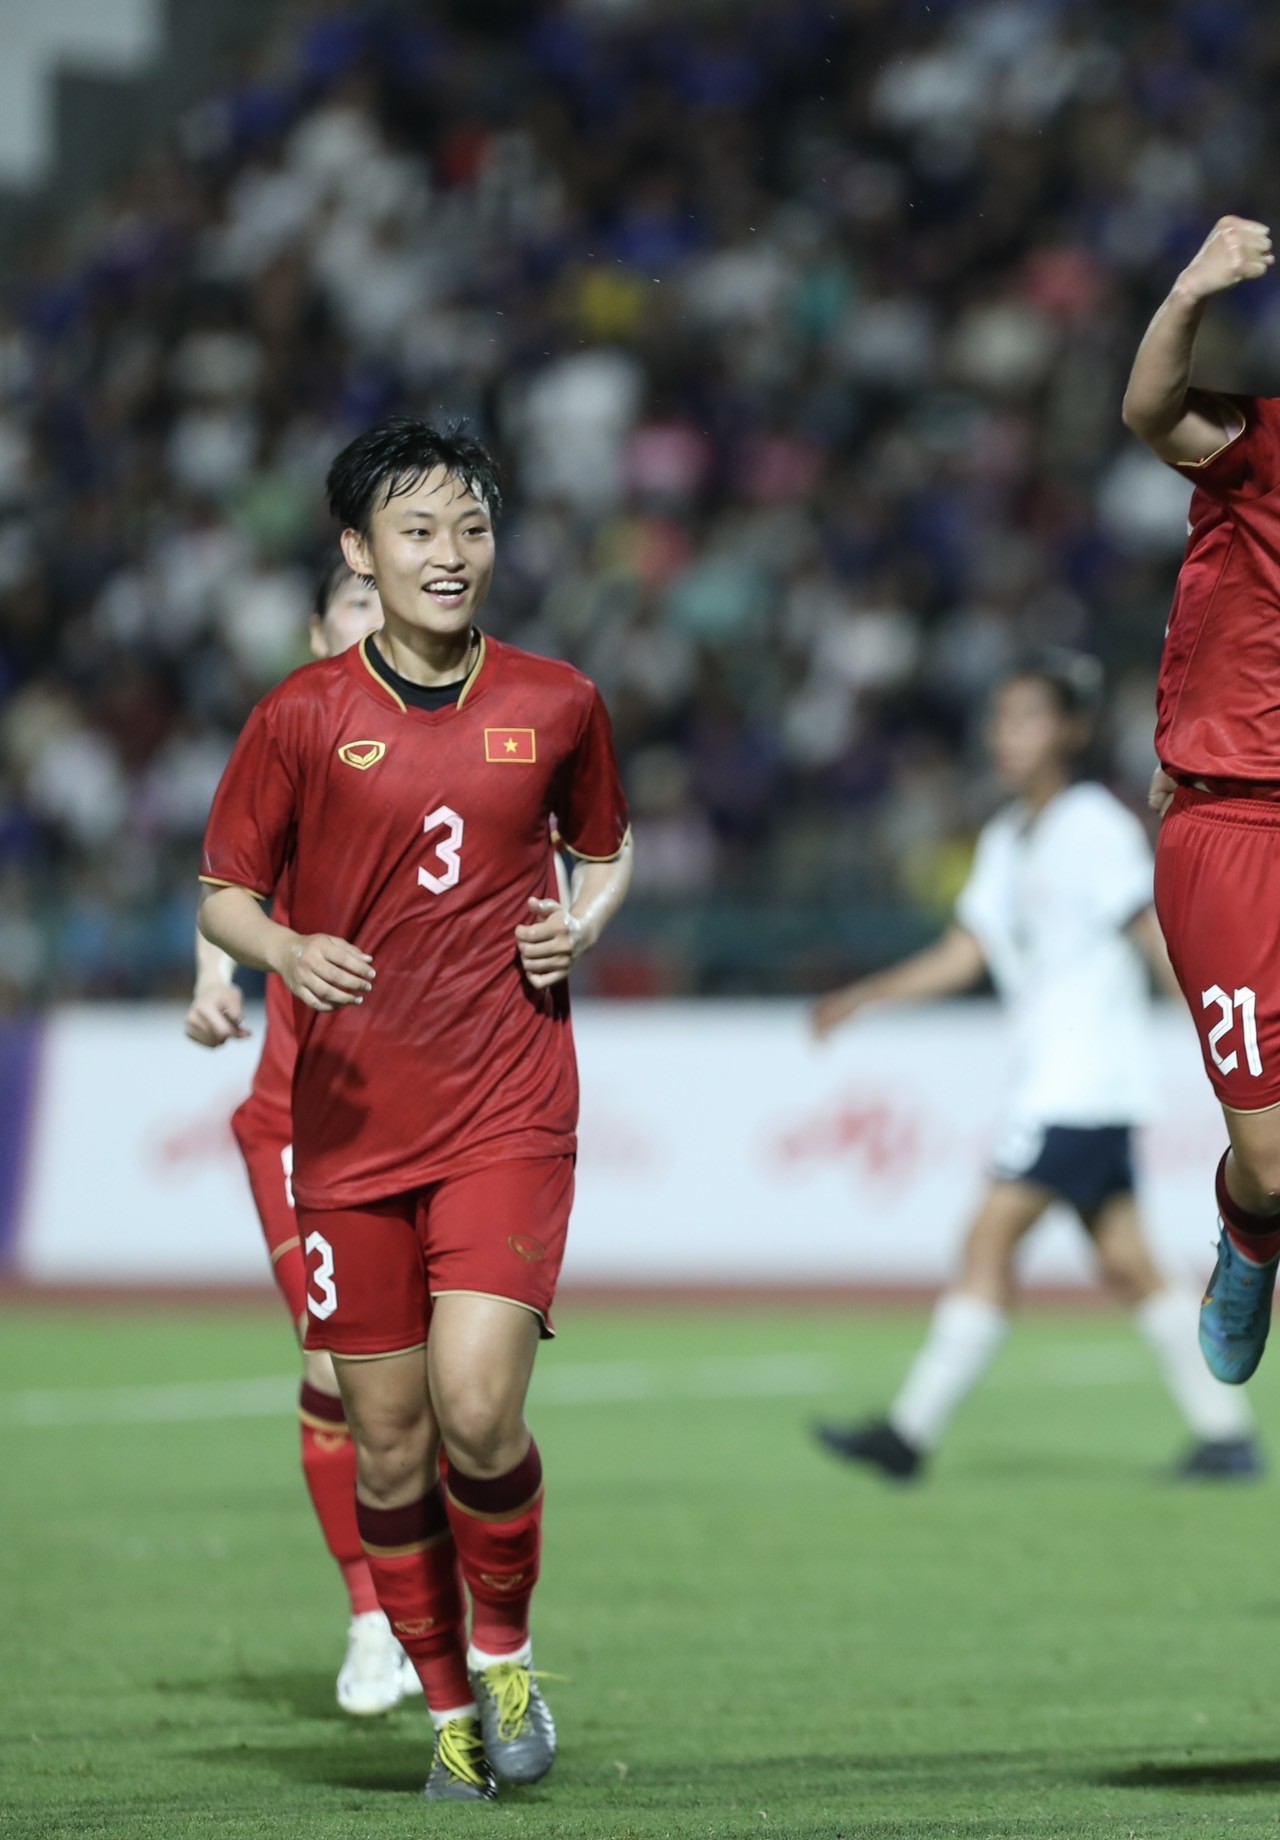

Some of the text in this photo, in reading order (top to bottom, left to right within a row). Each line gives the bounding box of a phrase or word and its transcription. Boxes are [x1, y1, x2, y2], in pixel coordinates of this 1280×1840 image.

[417, 805, 465, 895] 3
[1202, 984, 1263, 1077] 21
[304, 1230, 338, 1321] 3
